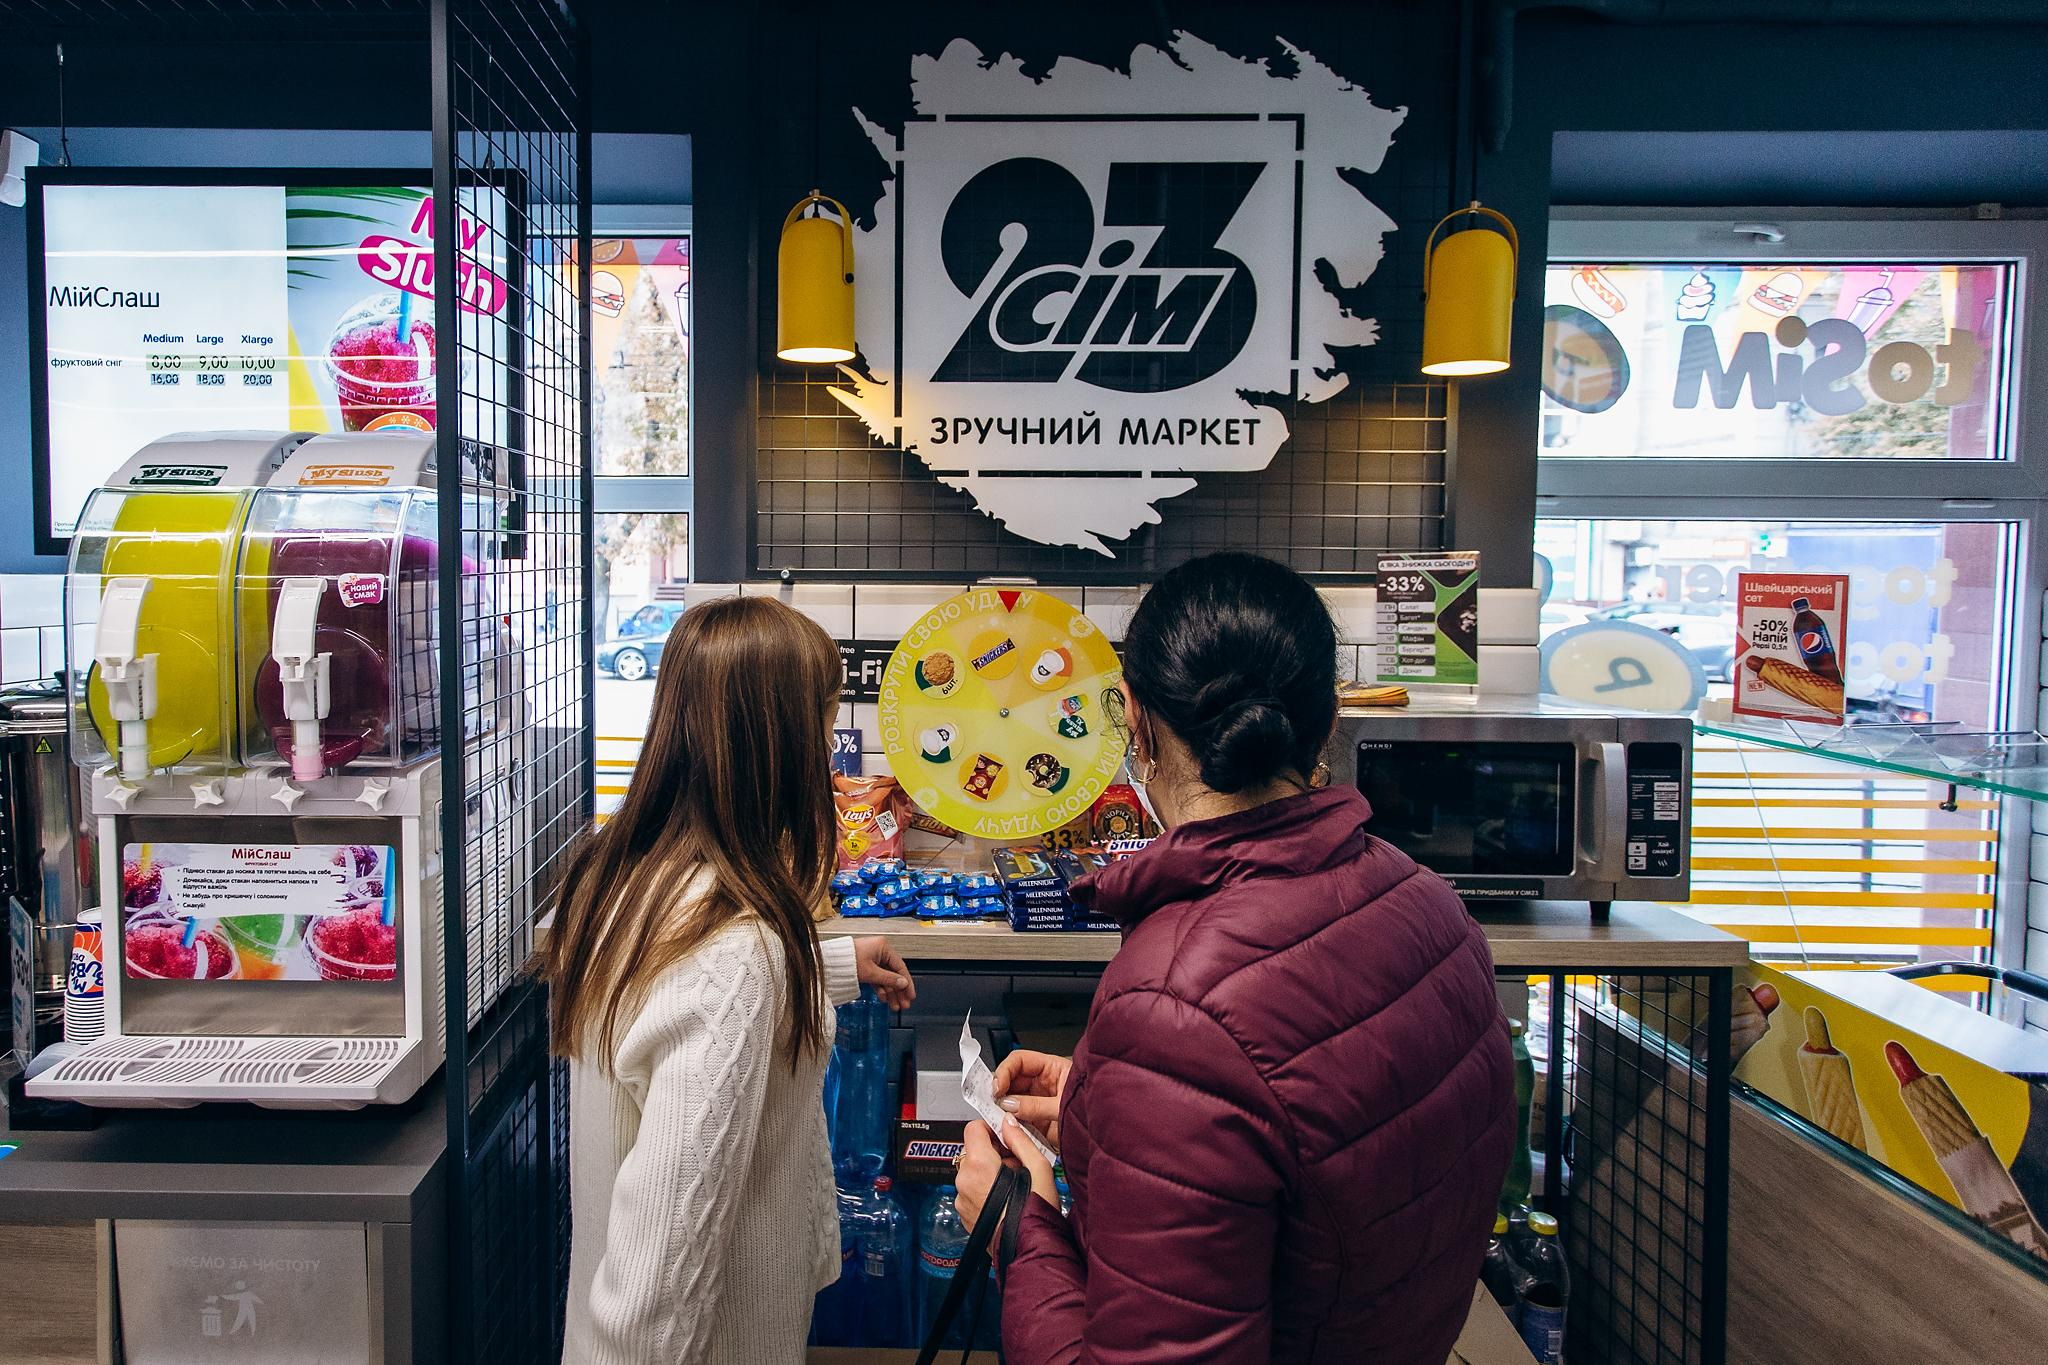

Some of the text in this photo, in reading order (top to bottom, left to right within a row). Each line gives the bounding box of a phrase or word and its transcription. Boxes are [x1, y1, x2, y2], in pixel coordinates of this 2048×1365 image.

[929, 157, 1268, 393] 23
[49, 286, 160, 308] МійСлаш
[143, 334, 273, 346] Medium Large Xlarge
[50, 357, 123, 368] фруктовий сніг
[151, 356, 275, 370] 8,00 9,00 10,00
[151, 374, 272, 386] 16,00 18,00 20,00
[930, 410, 1261, 446] ЗРУЧНИЙ МАРКЕТ
[1379, 576, 1425, 591] -33%
[1745, 582, 1833, 595] Швейцарський
[1745, 595, 1764, 603] сет
[1753, 619, 1788, 633] -50%
[1752, 631, 1788, 644] Напій
[840, 646, 855, 654] free
[1752, 642, 1770, 650] Pepsi
[978, 642, 1009, 667] SNICKERS
[842, 658, 882, 685] i-Fi
[882, 591, 1034, 755] РОЗКРУТИ СВОЮ УДУ
[1045, 777, 1101, 825] СВОЮ
[1105, 809, 1130, 820] ЧОРНА
[974, 814, 1042, 835] УДАЧУ
[1107, 831, 1130, 841] КАРТА
[231, 848, 291, 859] МійСлаш
[1026, 890, 1062, 899] MILLENNIUM
[901, 1122, 930, 1130] 20x112.5g
